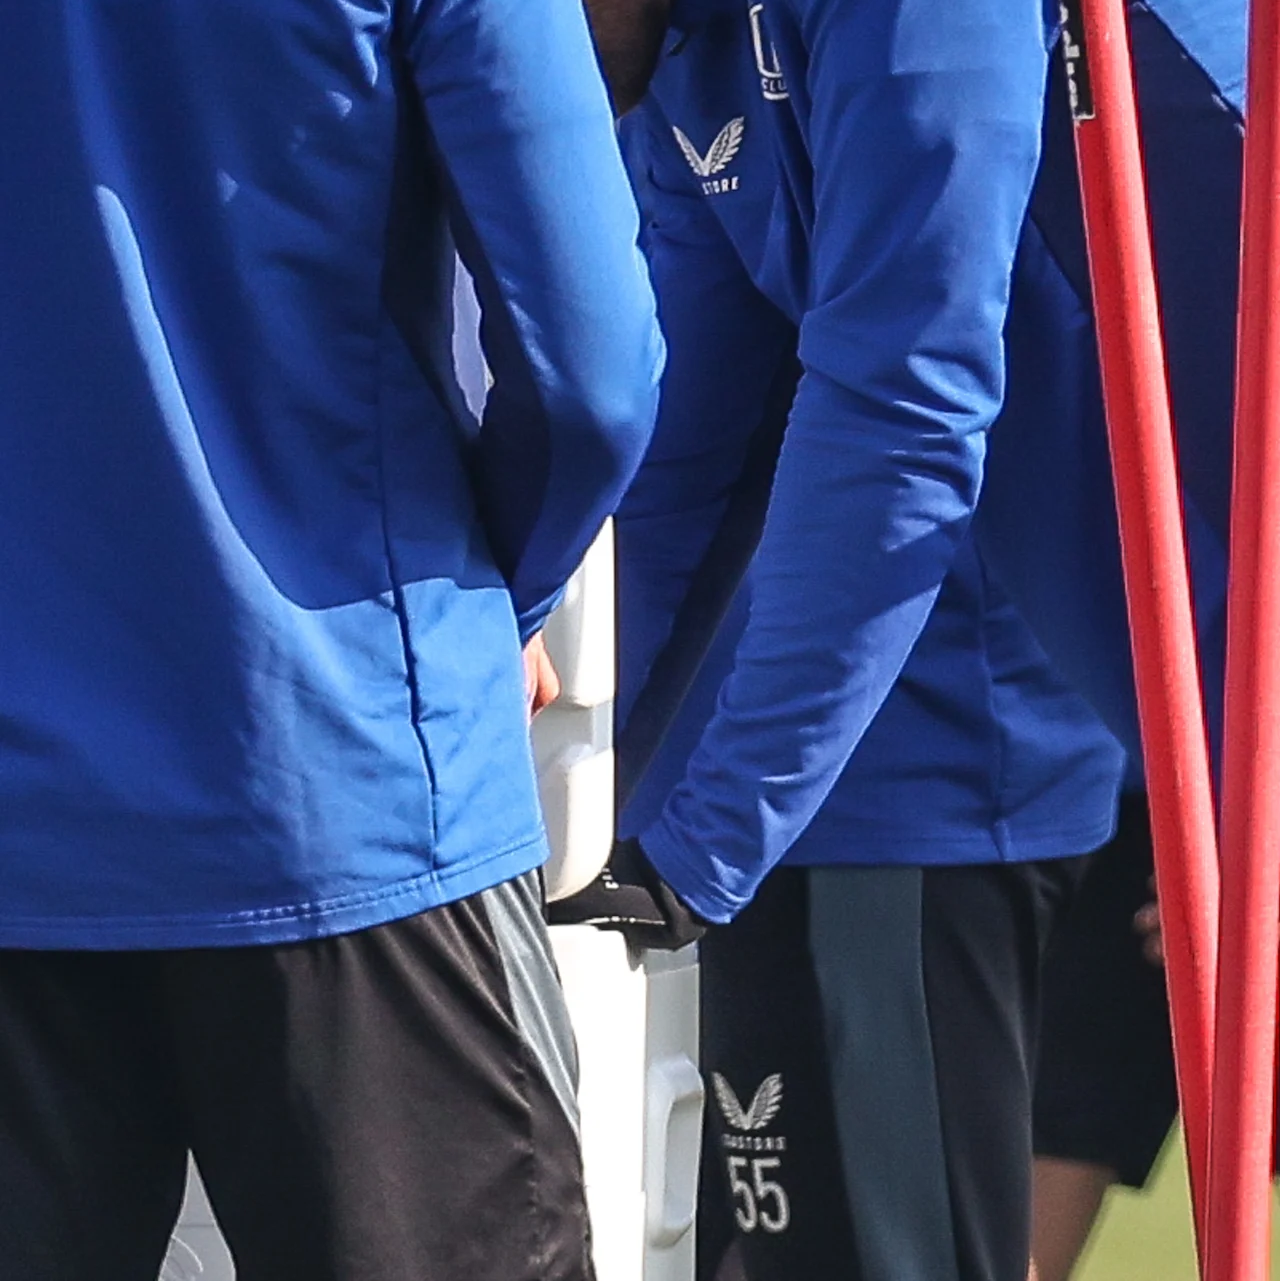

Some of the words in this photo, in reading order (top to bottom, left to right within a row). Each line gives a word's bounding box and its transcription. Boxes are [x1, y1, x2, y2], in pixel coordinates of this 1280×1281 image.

[761, 77, 788, 91] CLU
[702, 176, 739, 195] STORE
[726, 1155, 791, 1233] 55
